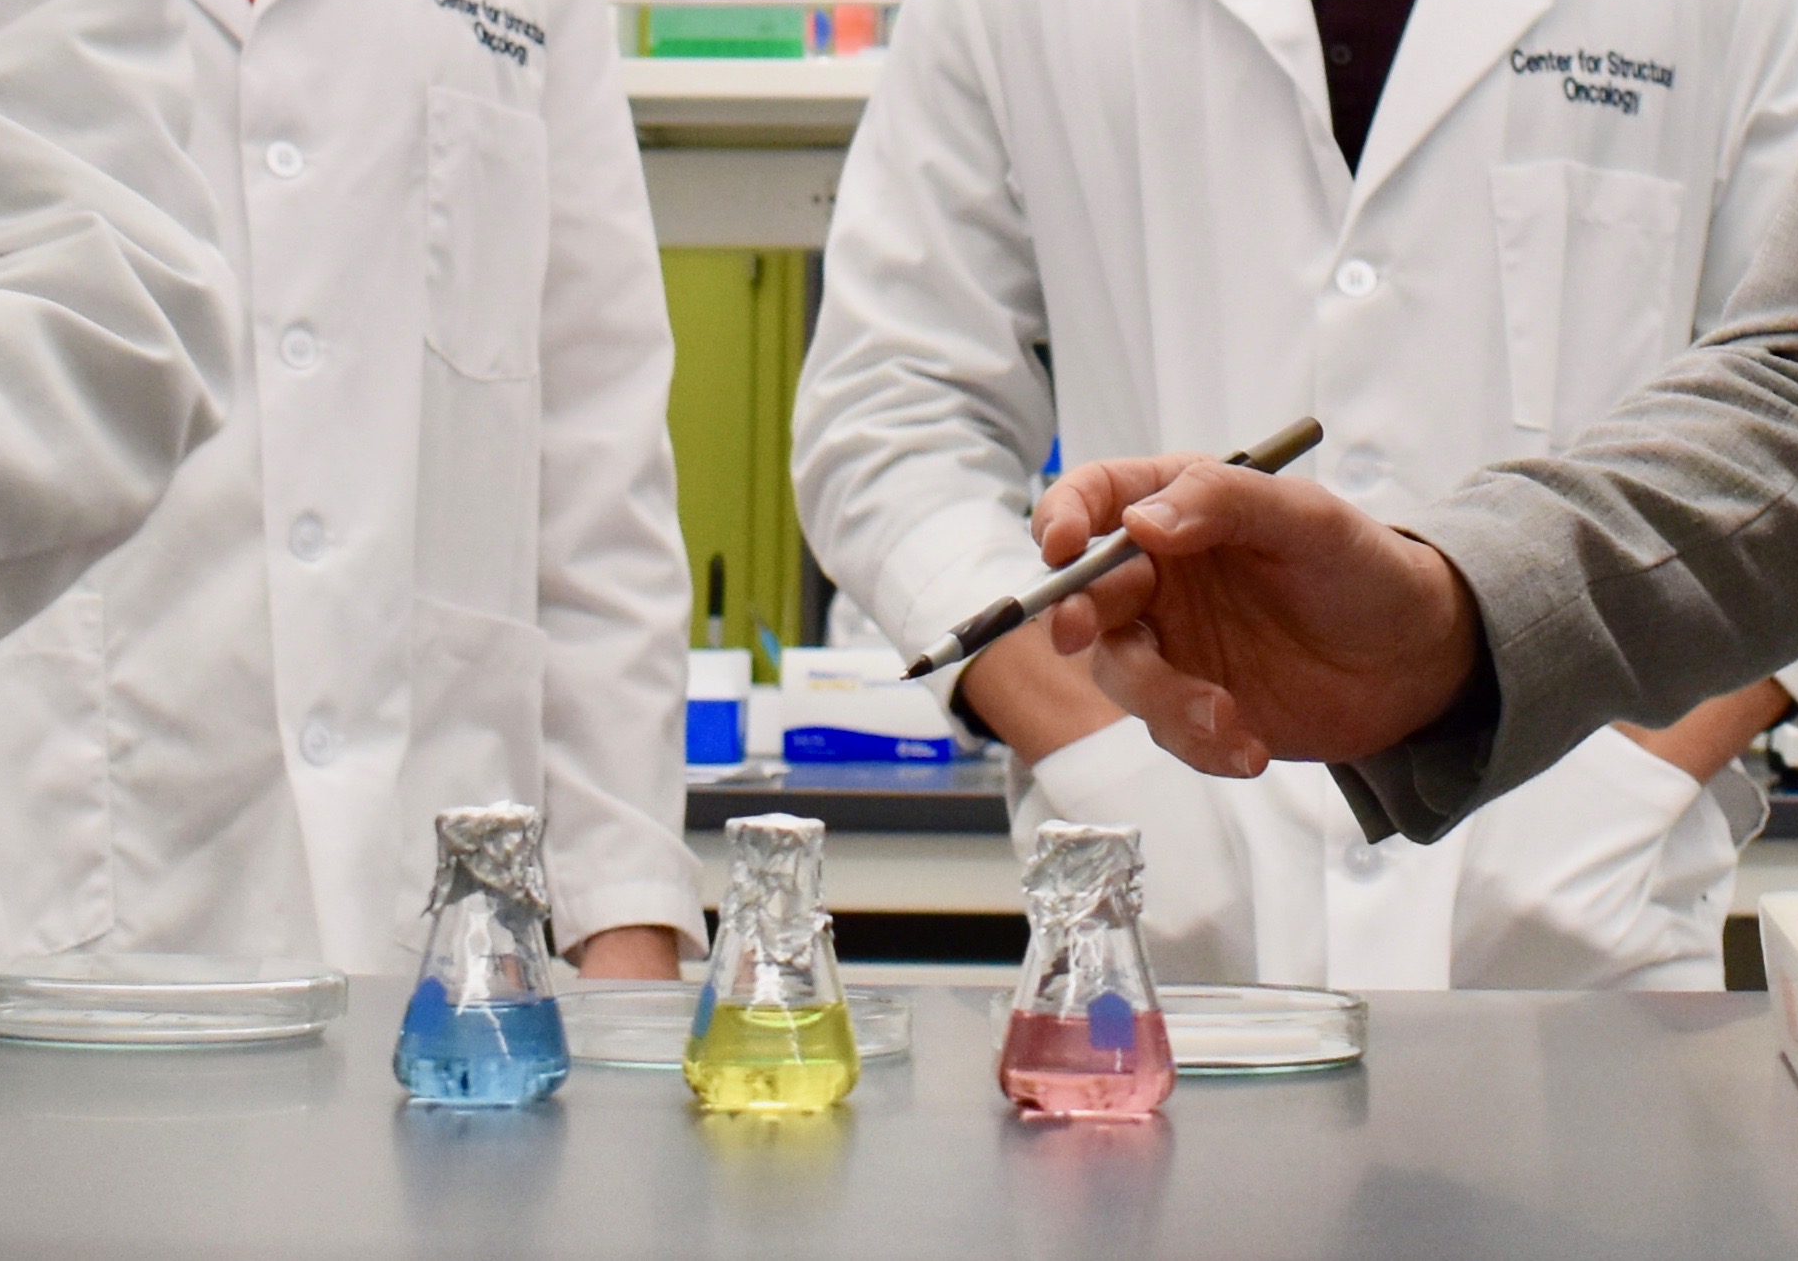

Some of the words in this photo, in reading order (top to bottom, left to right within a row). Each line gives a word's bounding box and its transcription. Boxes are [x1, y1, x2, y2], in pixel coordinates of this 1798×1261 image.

[1511, 49, 1571, 74] Center
[1577, 48, 1602, 74] for
[1562, 76, 1640, 116] Oncology
